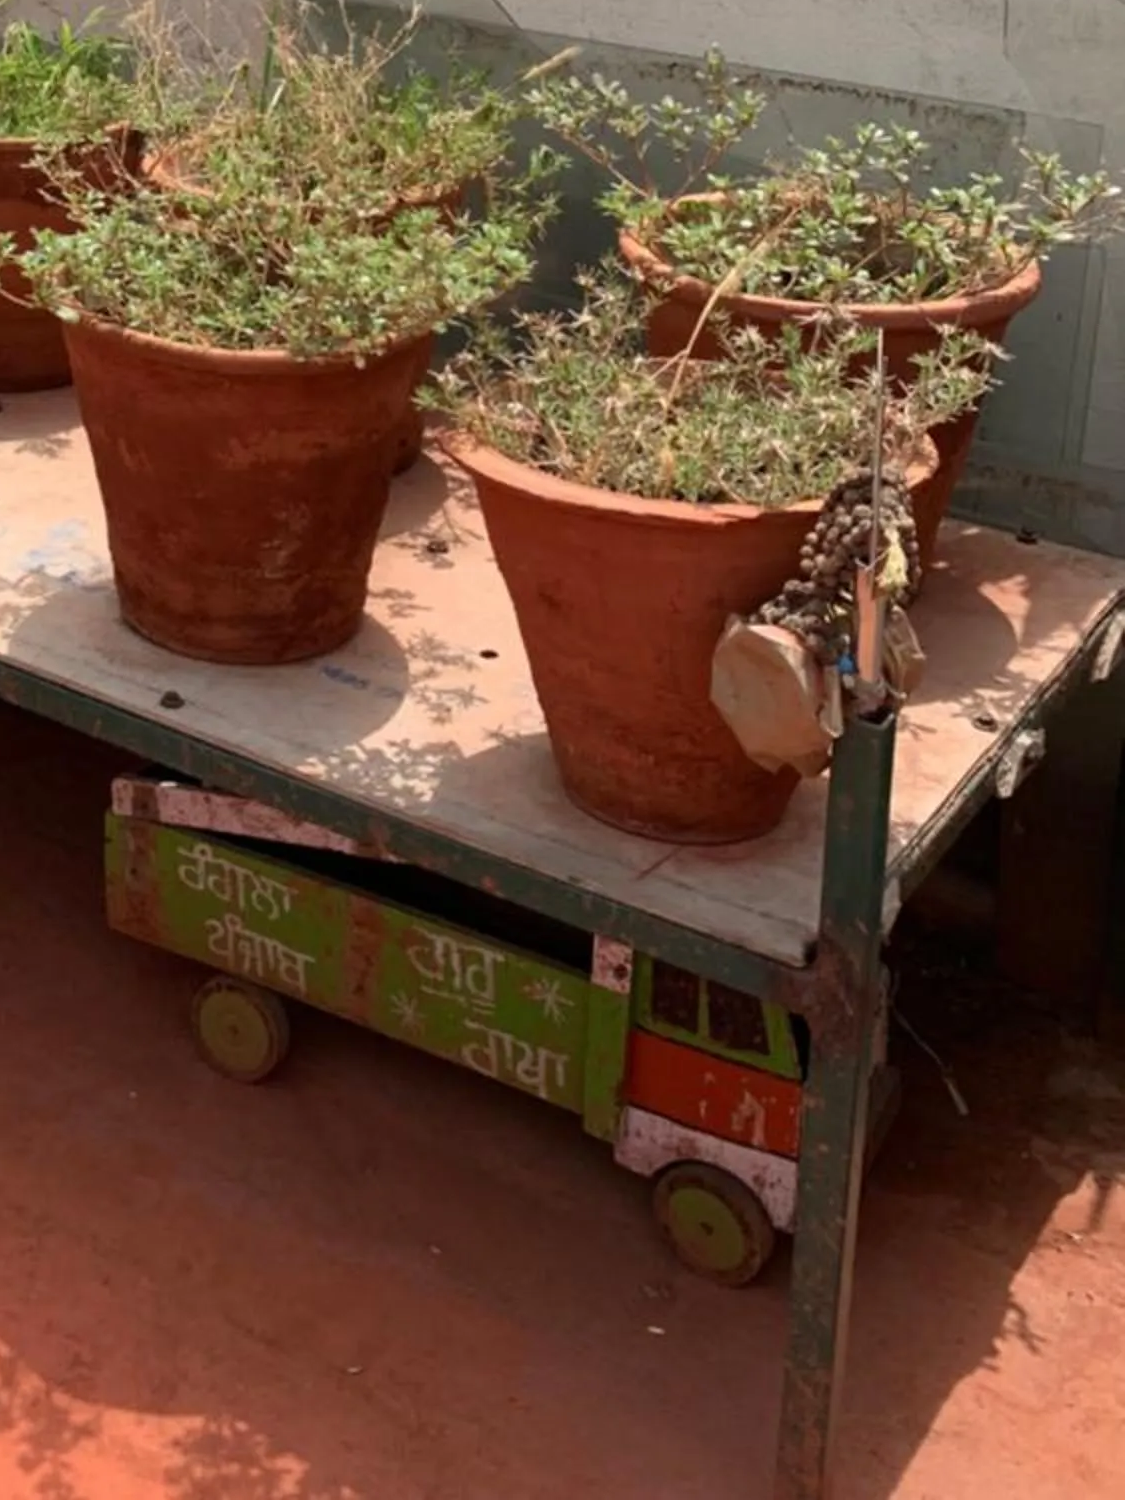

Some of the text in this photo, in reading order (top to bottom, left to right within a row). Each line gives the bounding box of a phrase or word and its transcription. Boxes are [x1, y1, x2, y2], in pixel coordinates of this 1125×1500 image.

[177, 843, 298, 919] ਰੰਗਲਾ
[204, 911, 316, 997] ਪੰਜਾਬ
[408, 923, 505, 1015] ਗੁਰੂ
[463, 1020, 570, 1098] ਰਾਖਾ
